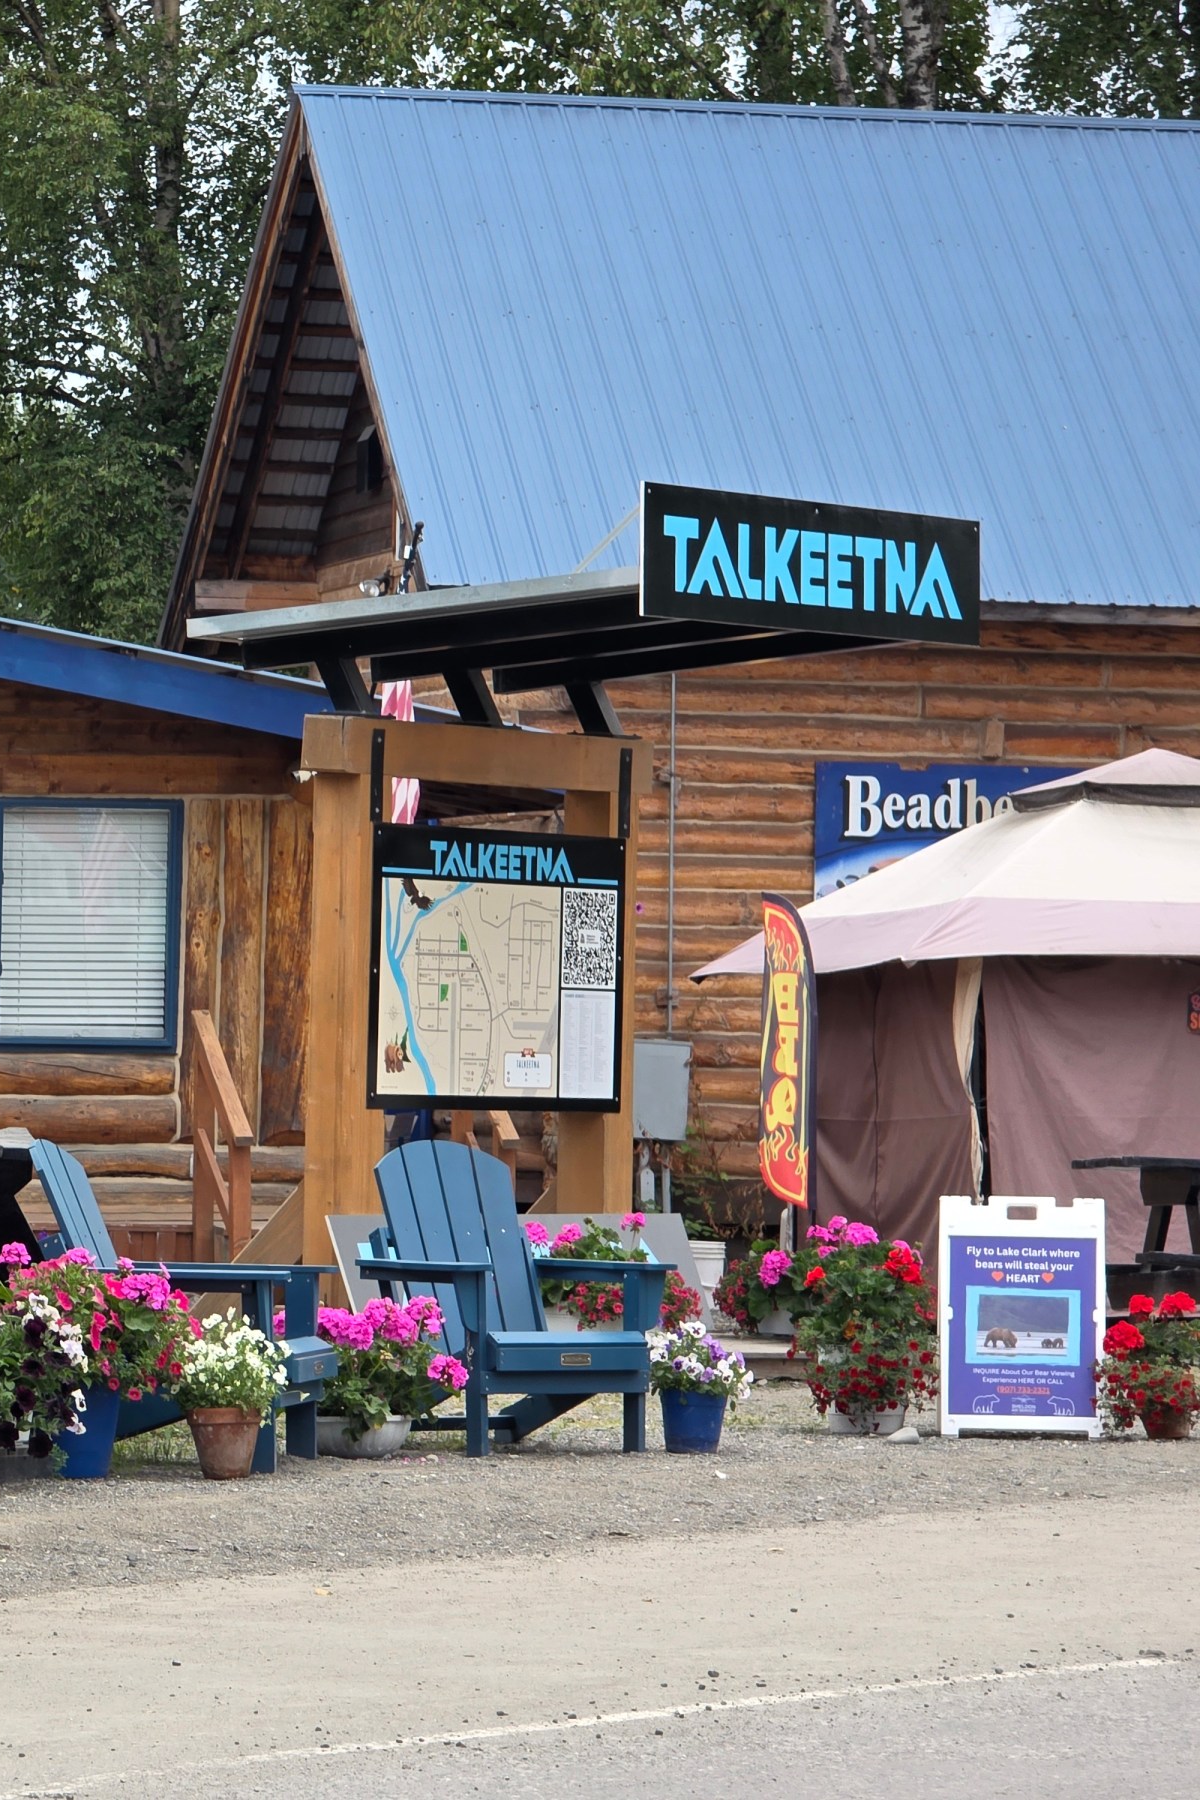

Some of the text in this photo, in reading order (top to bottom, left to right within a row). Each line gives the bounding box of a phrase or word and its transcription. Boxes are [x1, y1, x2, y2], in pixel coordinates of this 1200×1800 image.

[663, 514, 963, 620] TALKEETNA
[430, 840, 575, 883] TALKEETNA
[966, 1246, 1080, 1258] Fly to Lake Clark where
[975, 1259, 1074, 1272] bears will steal your
[1006, 1274, 1040, 1283] HEART
[1050, 1370, 1075, 1378] Viewing
